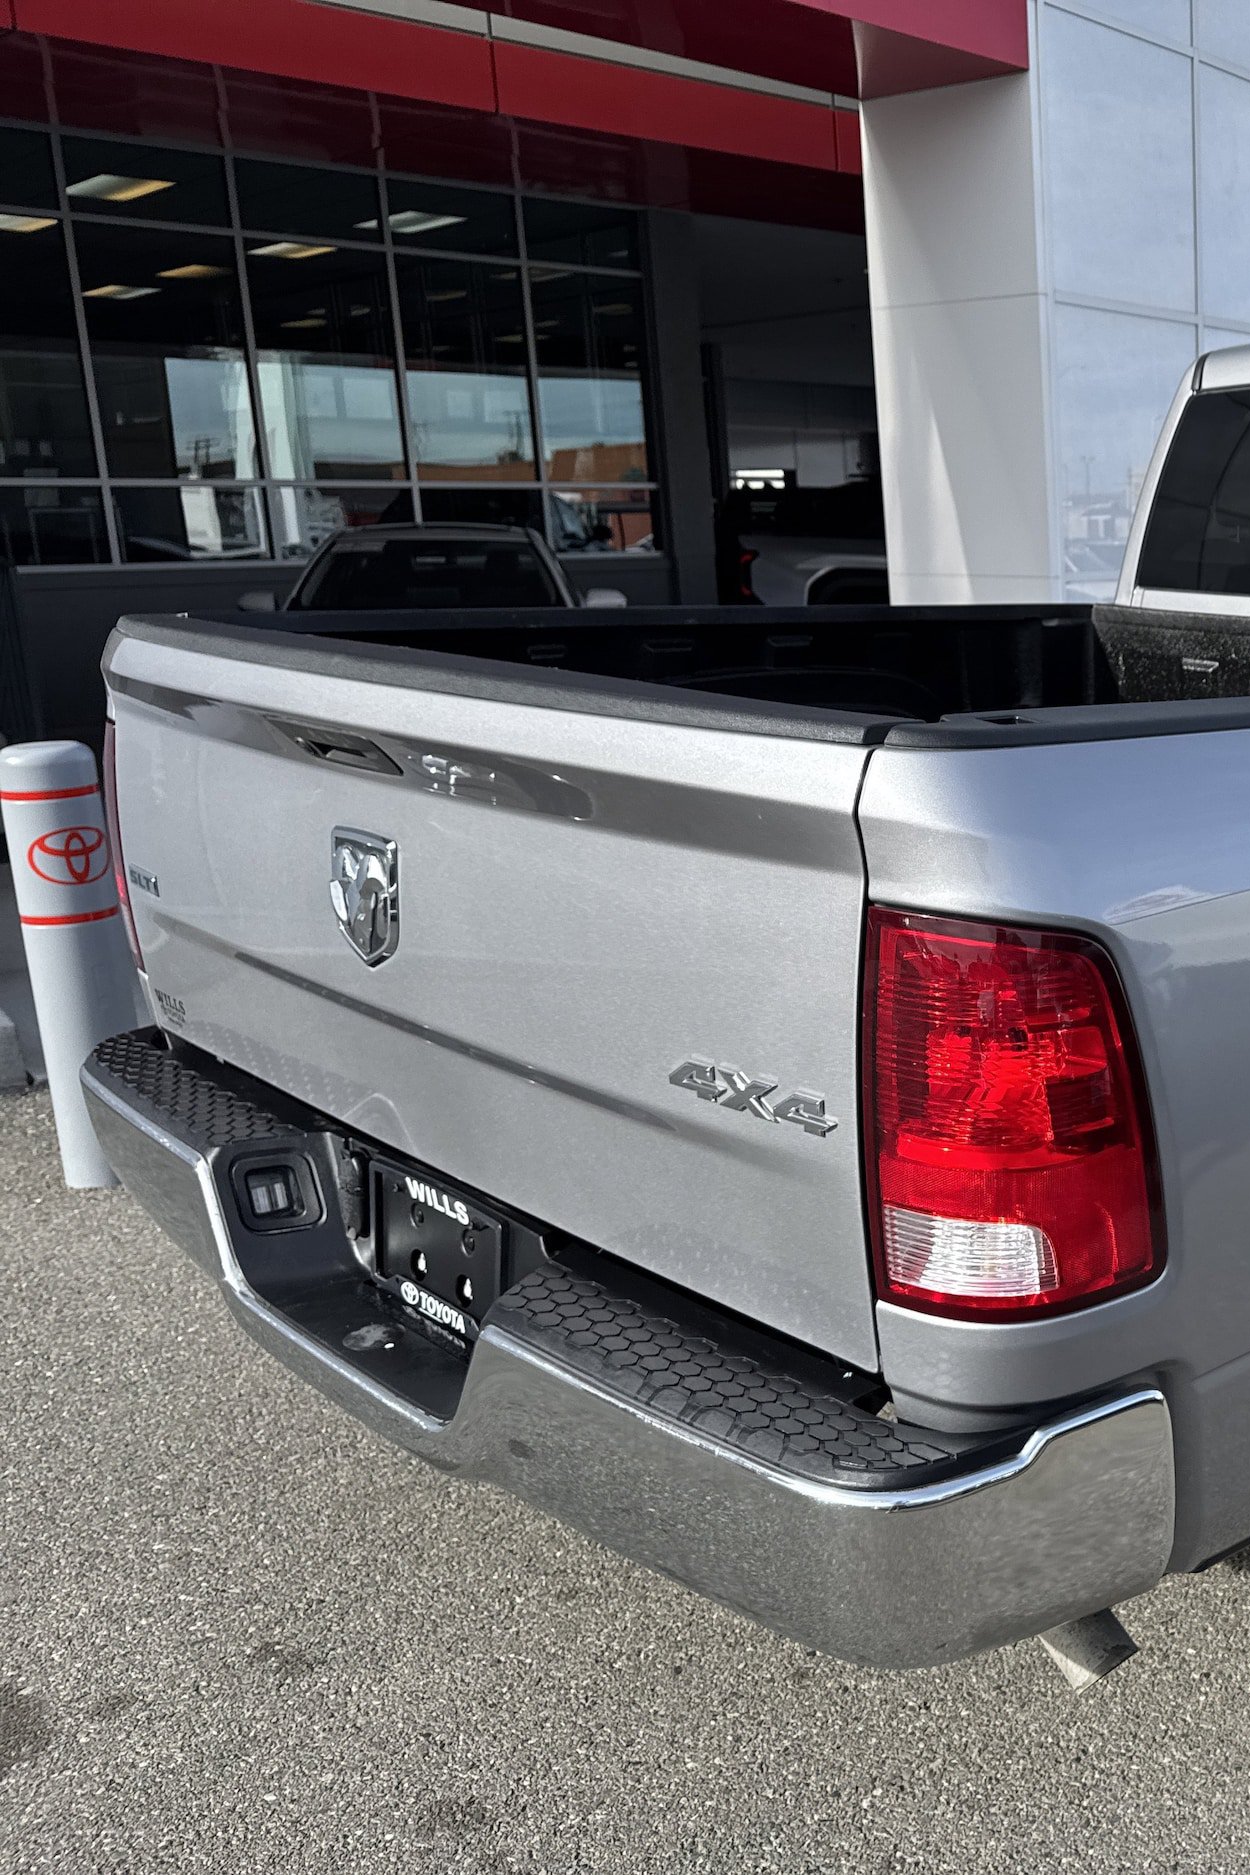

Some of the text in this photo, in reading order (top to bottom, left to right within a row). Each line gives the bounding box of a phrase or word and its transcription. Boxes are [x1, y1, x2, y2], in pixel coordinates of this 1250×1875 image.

[129, 868, 153, 892] SLT
[154, 988, 185, 1015] WILLS
[404, 1176, 470, 1226] WILLS
[418, 1291, 466, 1334] TOYOTA
